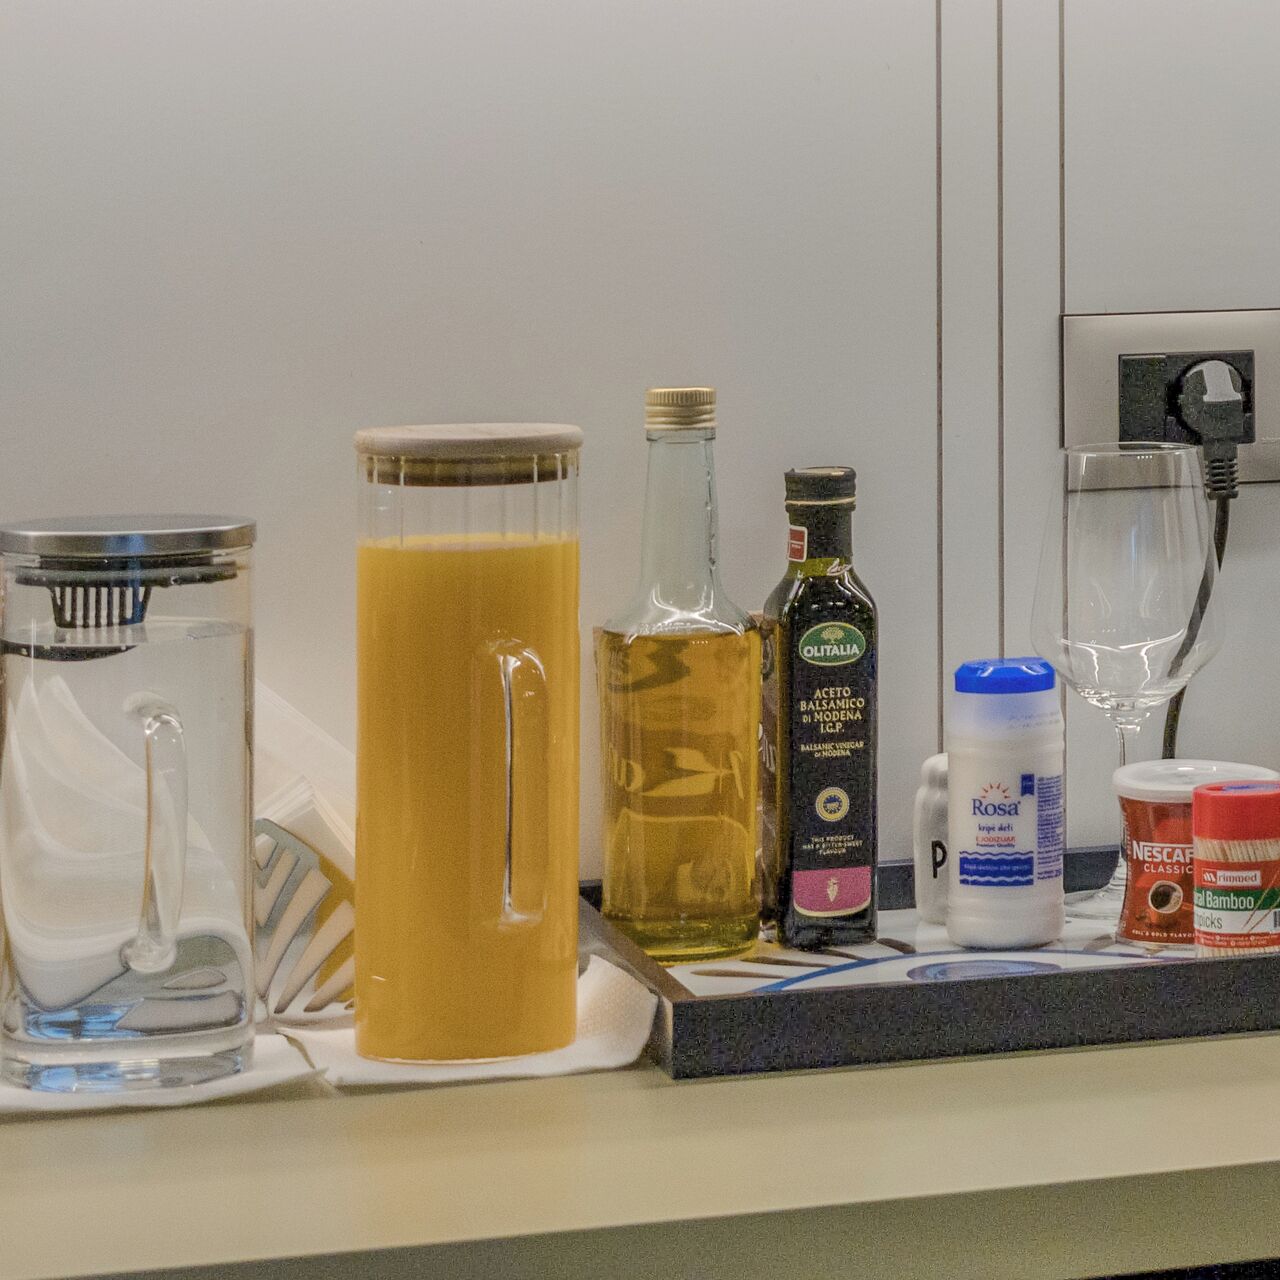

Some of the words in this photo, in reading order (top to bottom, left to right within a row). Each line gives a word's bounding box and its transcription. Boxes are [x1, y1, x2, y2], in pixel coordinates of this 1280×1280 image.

[803, 643, 860, 658] OLITALIA
[814, 687, 851, 699] ACETO
[800, 698, 865, 712] BALSAMICO
[814, 710, 863, 722] MODENA
[971, 798, 1019, 817] Rosa
[1143, 863, 1193, 874] CLASSIC
[1206, 890, 1255, 910] Bamboo
